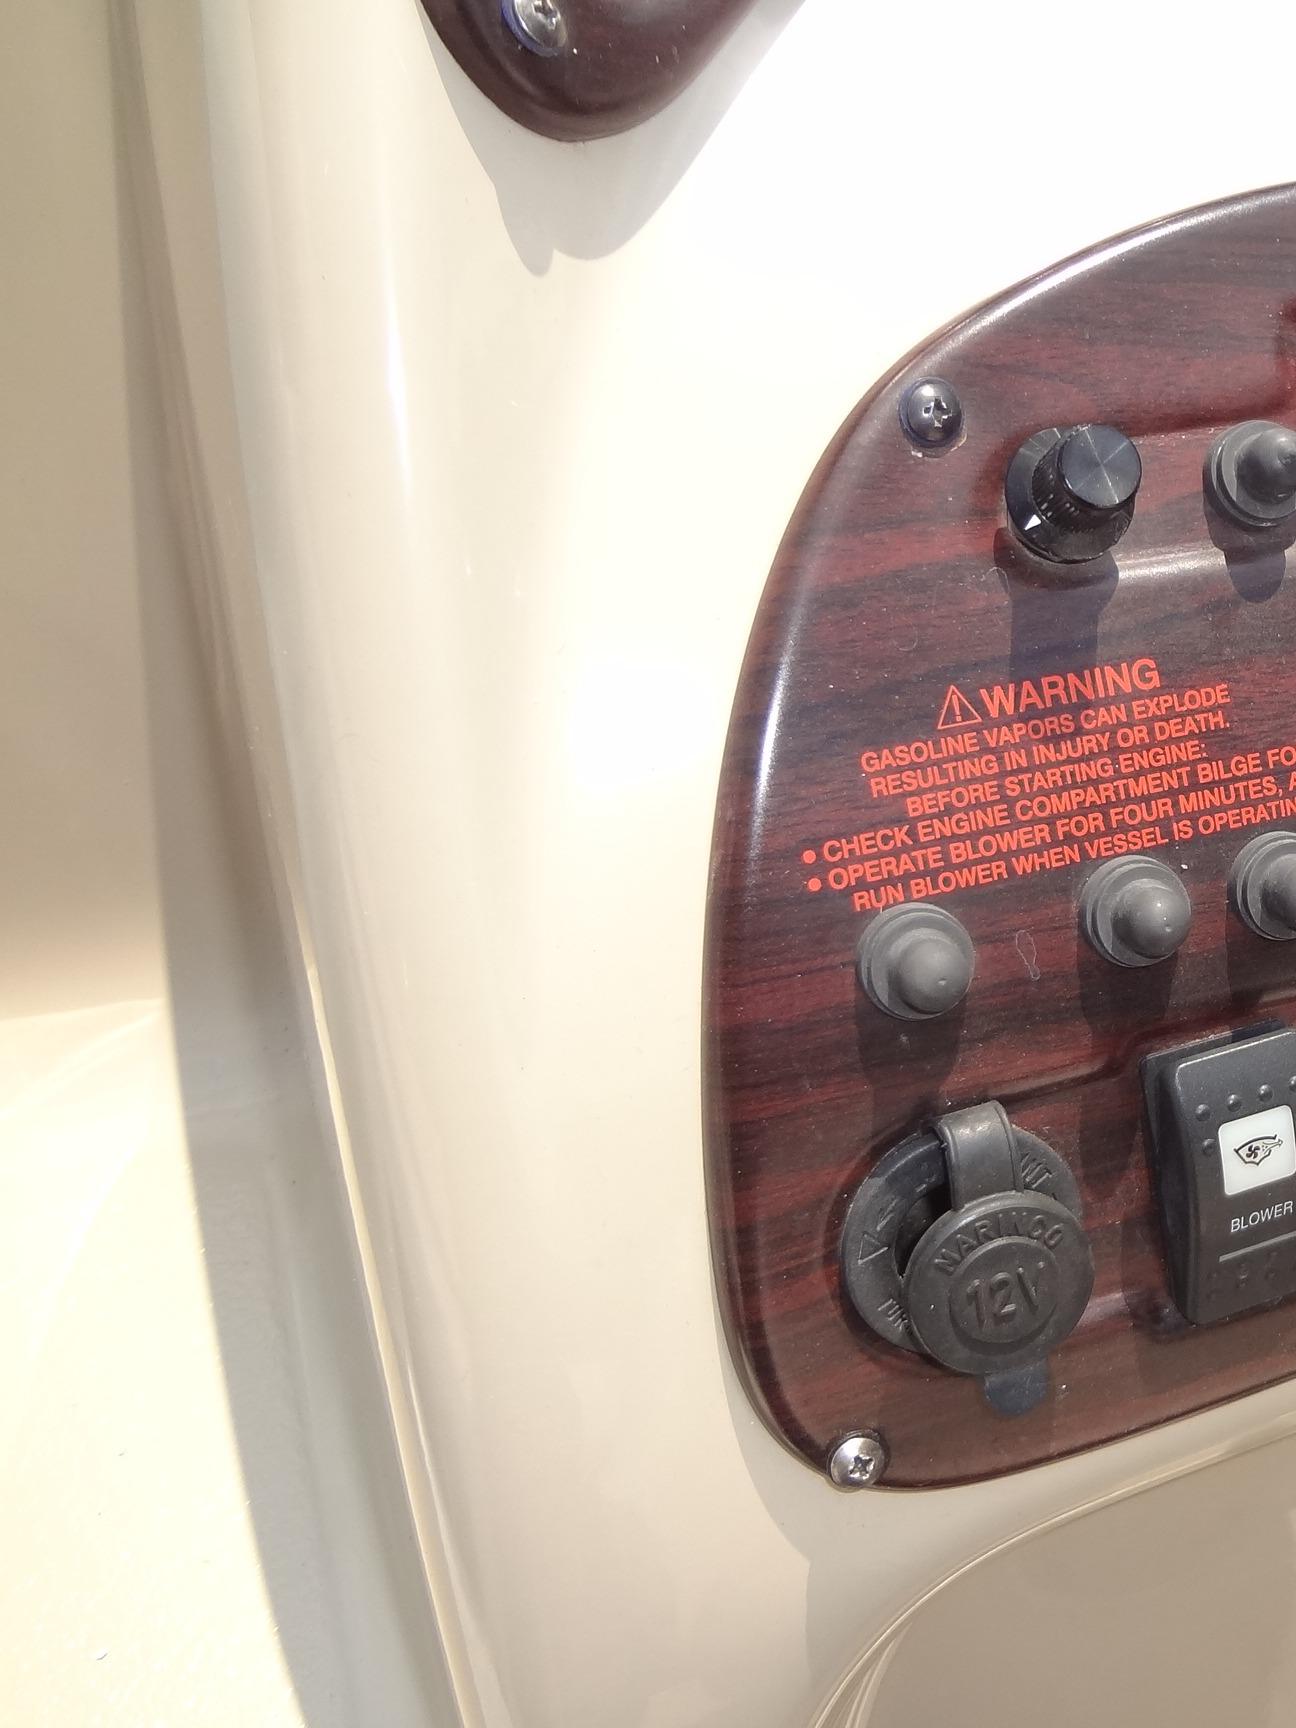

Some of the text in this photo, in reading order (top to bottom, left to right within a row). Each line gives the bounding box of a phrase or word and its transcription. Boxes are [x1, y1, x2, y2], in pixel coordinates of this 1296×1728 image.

[861, 684, 1230, 773] GASOLINE VAPORS CAN EXPLODE
[980, 658, 1160, 718] WARNING
[870, 710, 1230, 798] RESULTING IN INJURY OR DEATH.
[907, 742, 1208, 818] BEFORE STARTING ENGINE:
[823, 827, 911, 863] CHECK
[918, 806, 1009, 842] ENGINE
[1015, 768, 1190, 822] COMPARTMENT
[1198, 754, 1263, 784] BILGE
[828, 848, 945, 891] OPERATE
[950, 823, 1051, 864] BLOWER
[1056, 810, 1105, 840] FOR
[1110, 797, 1173, 828] FOUR
[1179, 776, 1283, 814] MINUTES,
[853, 883, 905, 912] RUN
[910, 861, 1008, 900] BLOWER
[1013, 843, 1081, 876] WHEN
[1085, 826, 1168, 860] VESSEL
[1172, 818, 1194, 841] IS
[934, 1212, 1065, 1276] MARINCO
[1230, 1200, 1295, 1234] BLOWER
